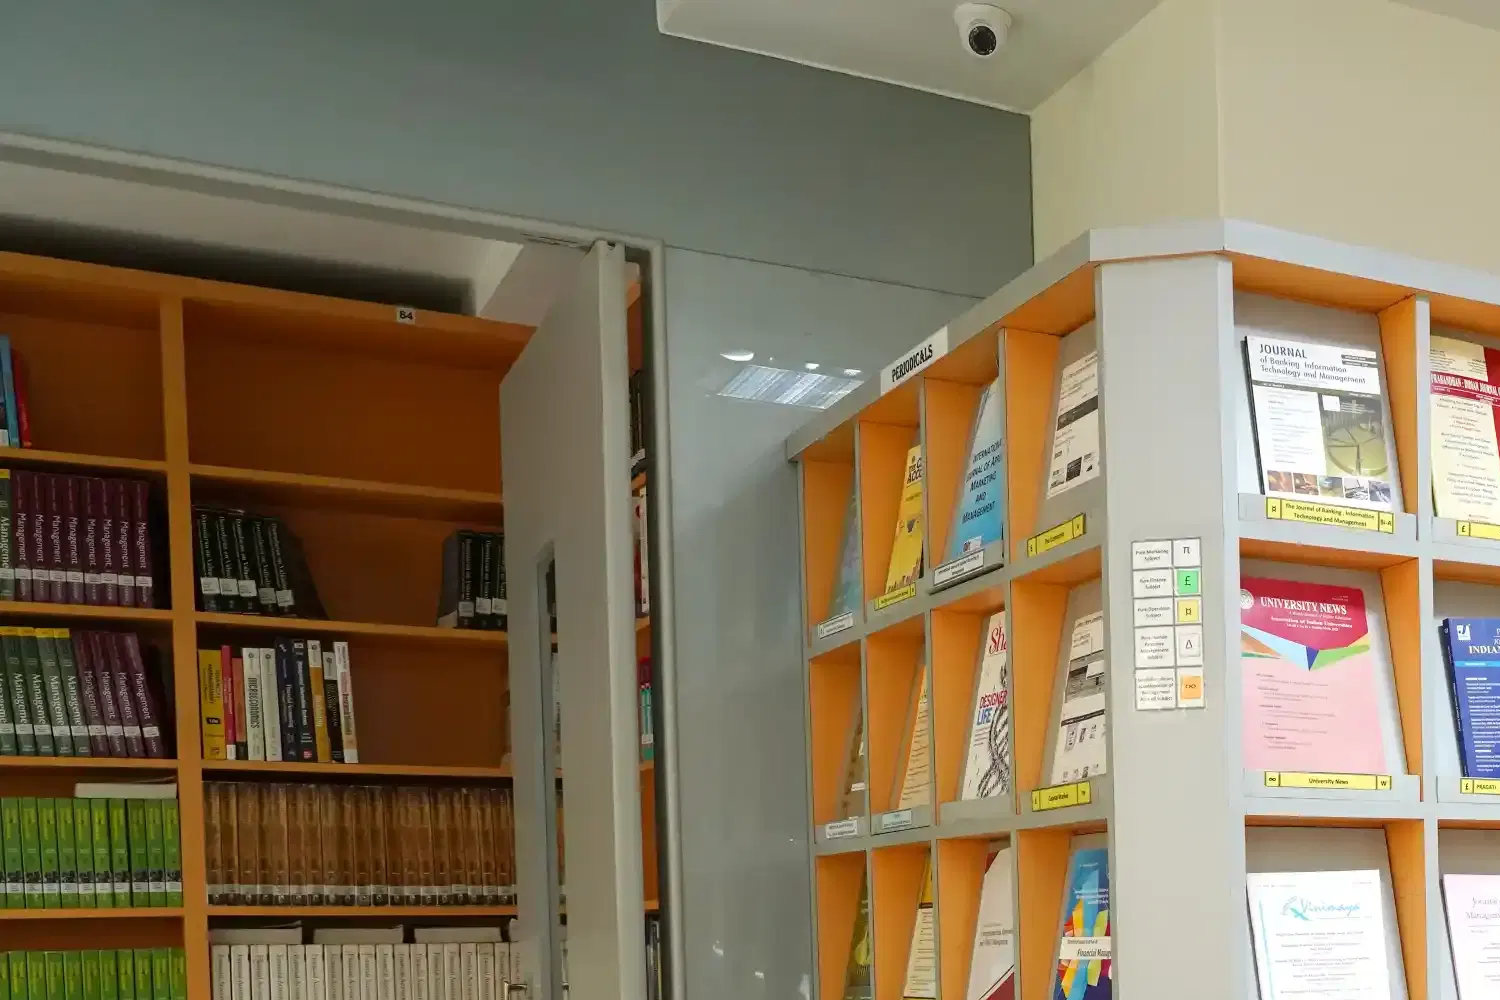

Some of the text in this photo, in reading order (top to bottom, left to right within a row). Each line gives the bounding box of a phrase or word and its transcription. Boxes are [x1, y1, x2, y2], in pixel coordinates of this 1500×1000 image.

[1260, 344, 1307, 359] JOURNAL
[892, 344, 933, 382] PERIODICALS
[970, 471, 996, 492] MARKETING
[976, 492, 986, 502] AND
[962, 501, 996, 524] MANAGEMENT
[1294, 513, 1322, 522] Technology
[1334, 517, 1366, 527] Management
[16, 512, 26, 561] Management
[34, 514, 44, 563] Management
[51, 516, 61, 564] Management
[1260, 597, 1347, 615] UNIVERSITY NEWS
[1308, 778, 1334, 786] University
